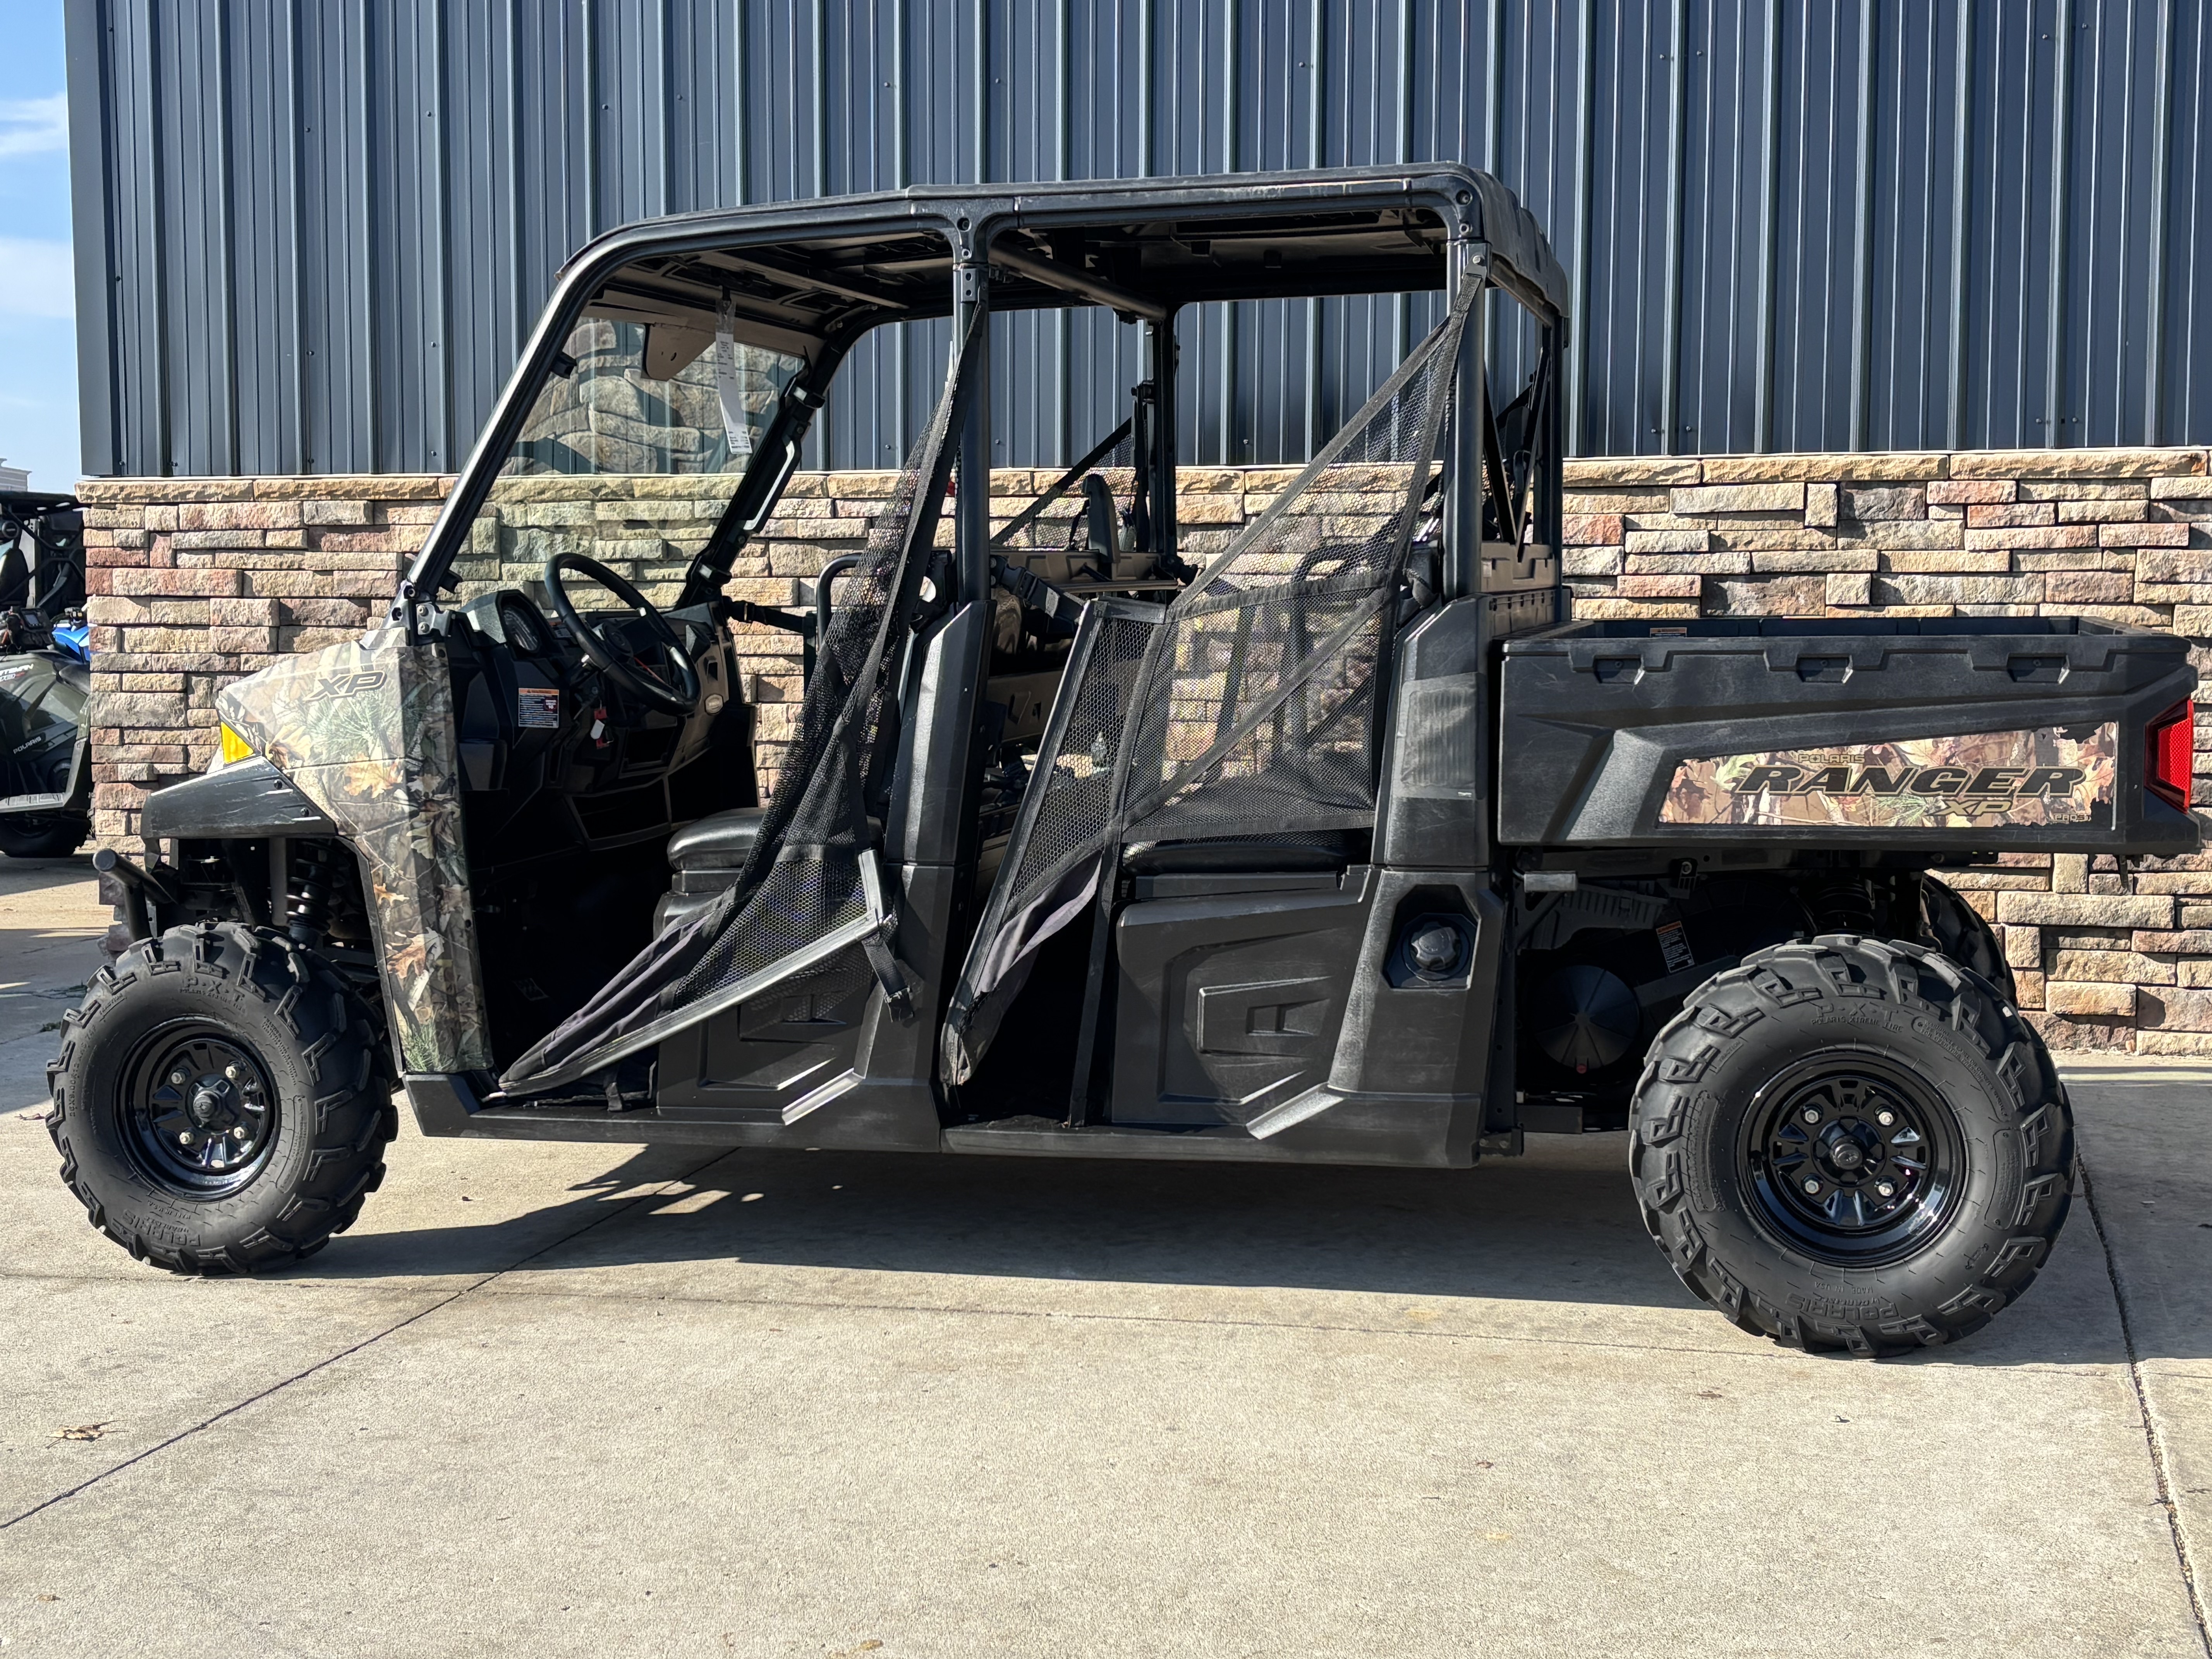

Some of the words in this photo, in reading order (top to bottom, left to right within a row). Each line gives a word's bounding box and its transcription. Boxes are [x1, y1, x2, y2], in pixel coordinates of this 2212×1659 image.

[303, 670, 387, 702] XP
[13, 736, 41, 754] POLARIS
[1798, 754, 1865, 763] POLARIS
[1735, 764, 2087, 798] RANGER
[1926, 799, 2013, 816] XP
[1812, 1017, 1846, 1025] POLARIS
[1885, 1022, 1903, 1032] TIRE
[122, 1209, 201, 1247] POLARIS
[1785, 1293, 1899, 1320] POLARIS
